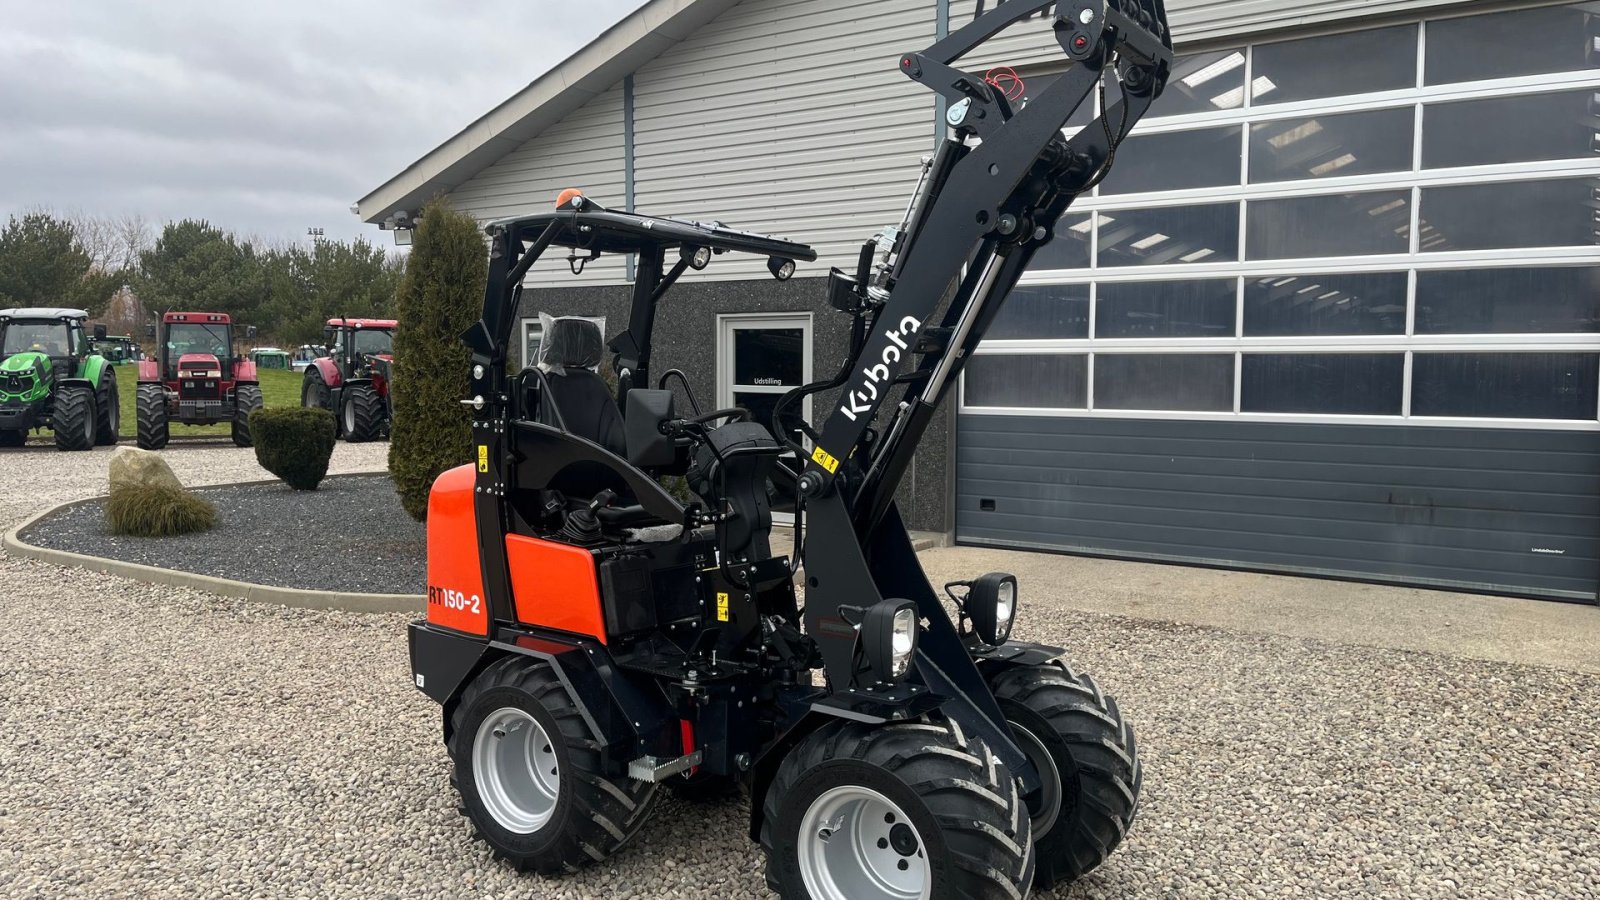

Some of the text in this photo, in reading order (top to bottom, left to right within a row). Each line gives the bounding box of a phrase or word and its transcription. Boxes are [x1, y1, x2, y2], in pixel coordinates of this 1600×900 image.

[754, 377, 782, 386] Udstilling
[840, 316, 921, 422] Kubota
[429, 585, 480, 614] RT150-2
